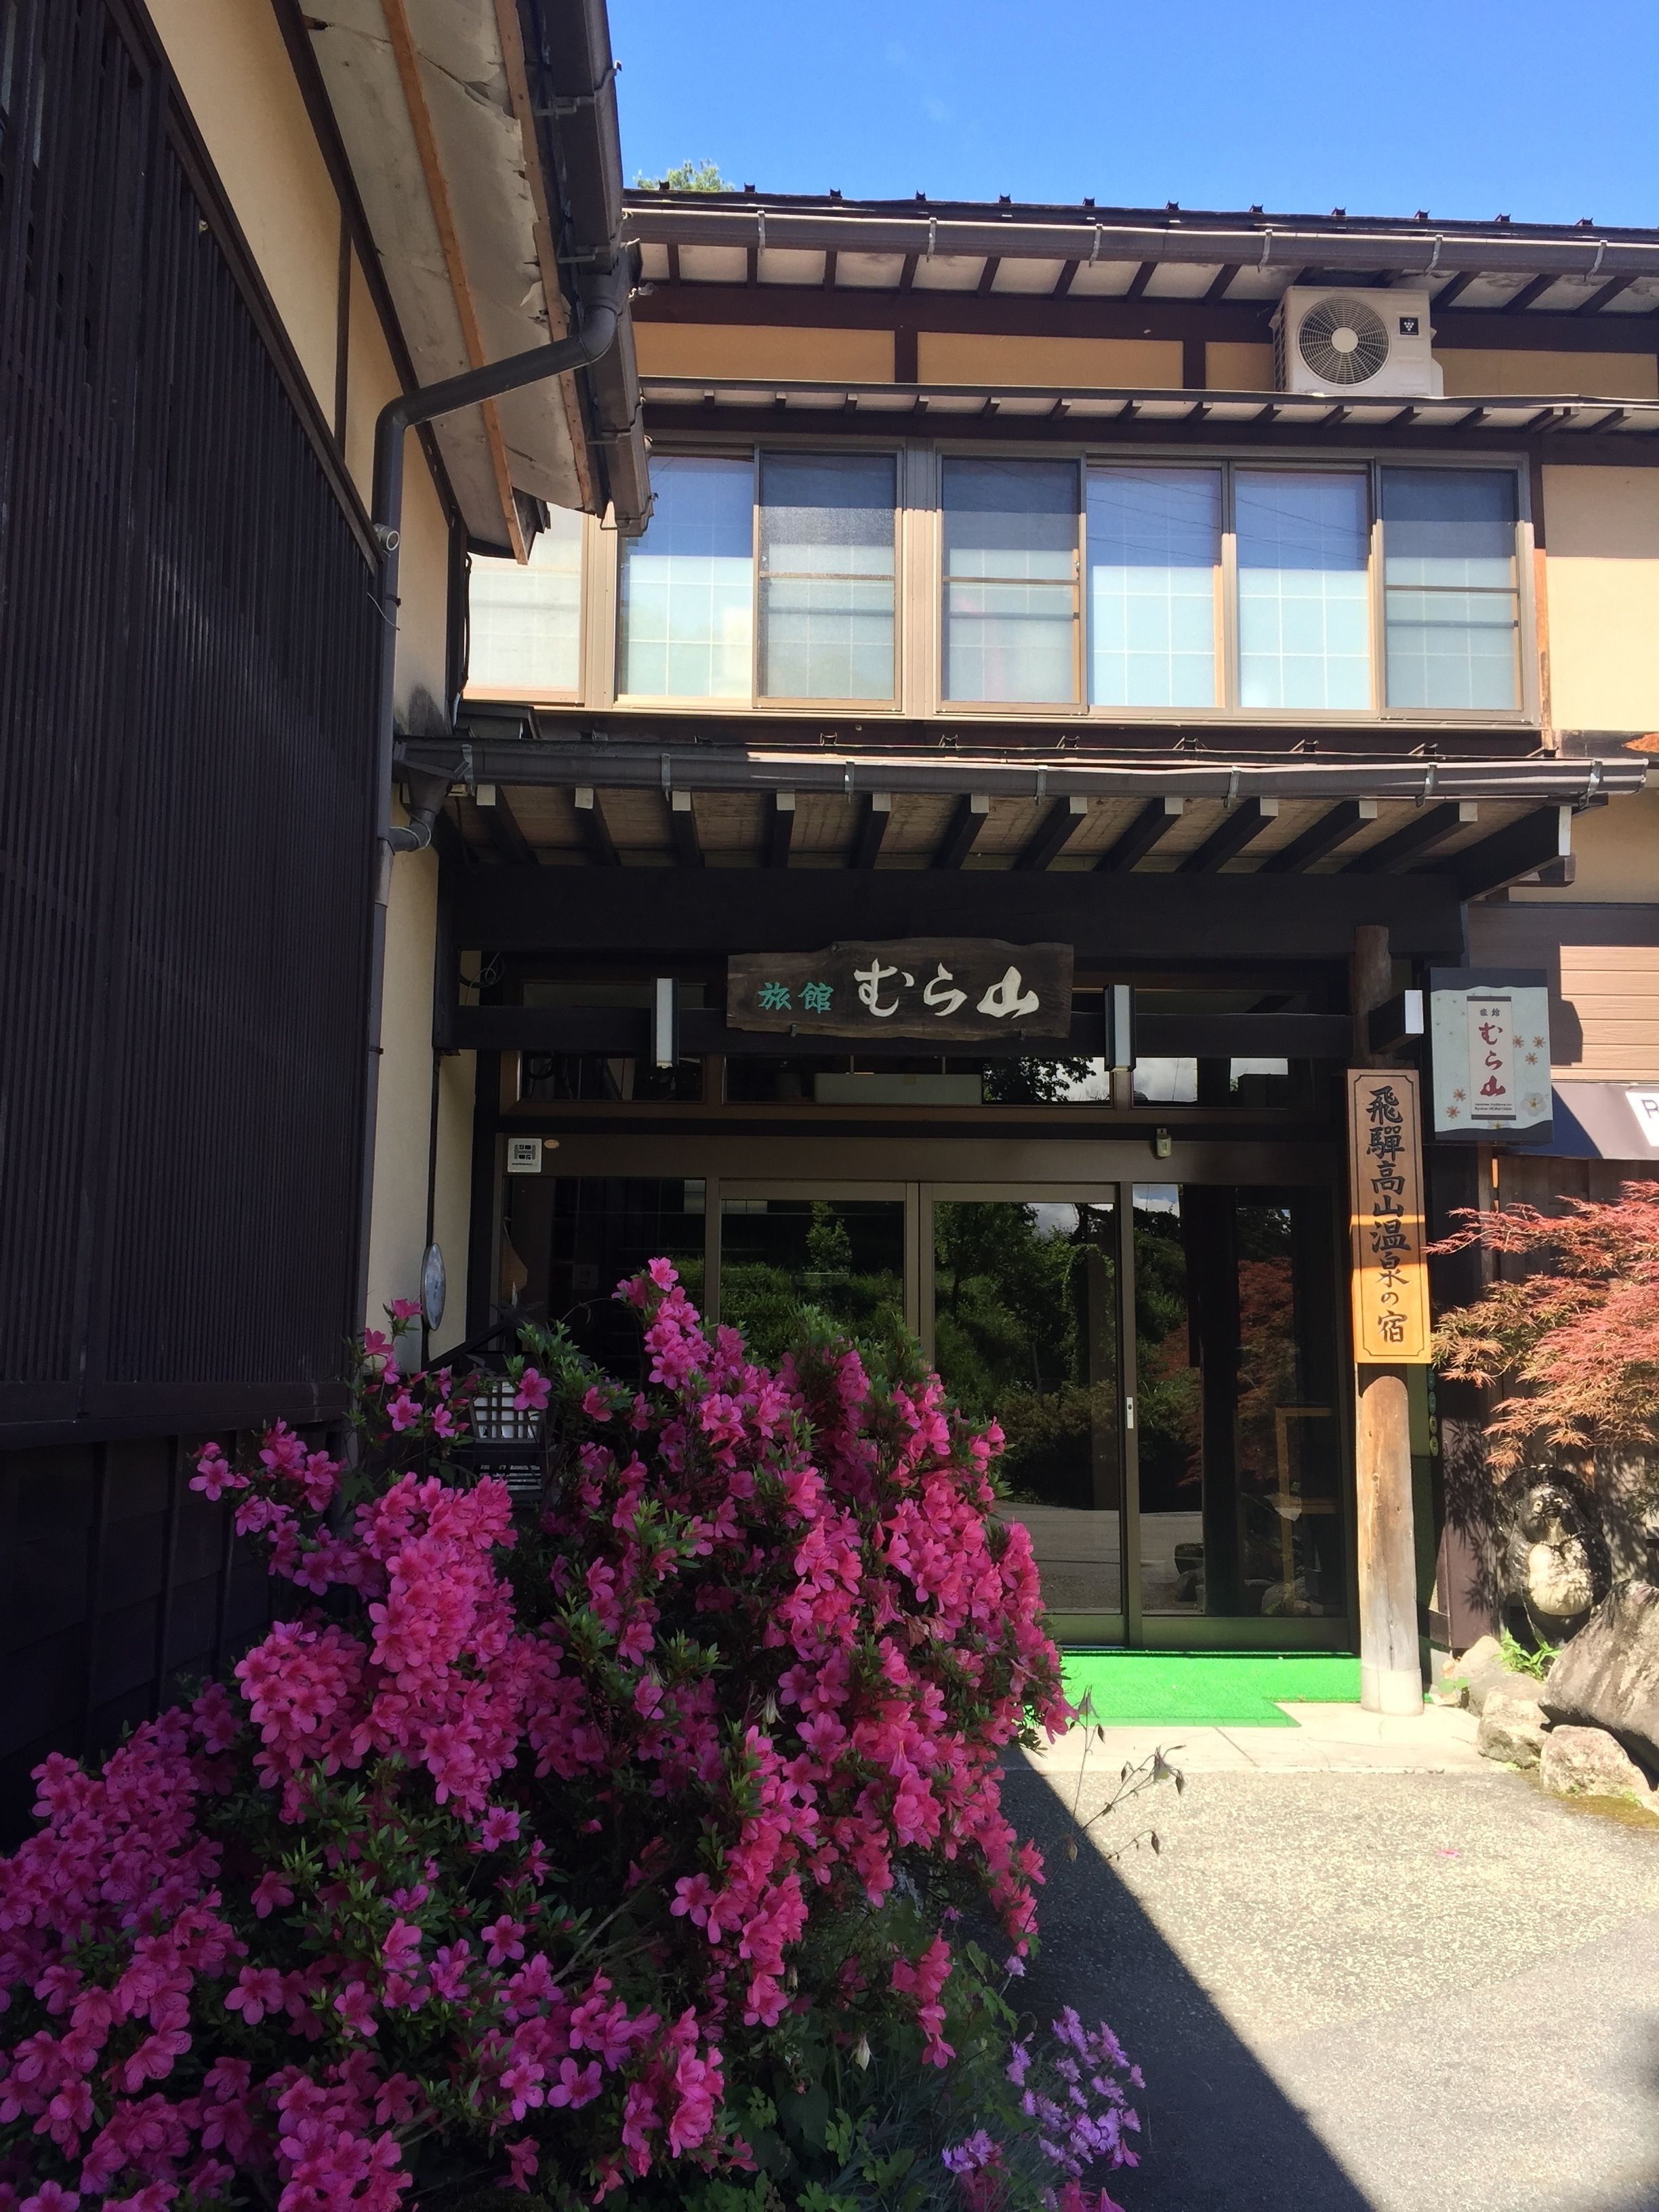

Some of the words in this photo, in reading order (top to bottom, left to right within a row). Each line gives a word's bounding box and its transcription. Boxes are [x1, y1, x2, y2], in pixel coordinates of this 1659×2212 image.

[758, 982, 834, 1013] 旅館
[854, 958, 1040, 1019] むら山
[1479, 1022, 1506, 1097] むら山
